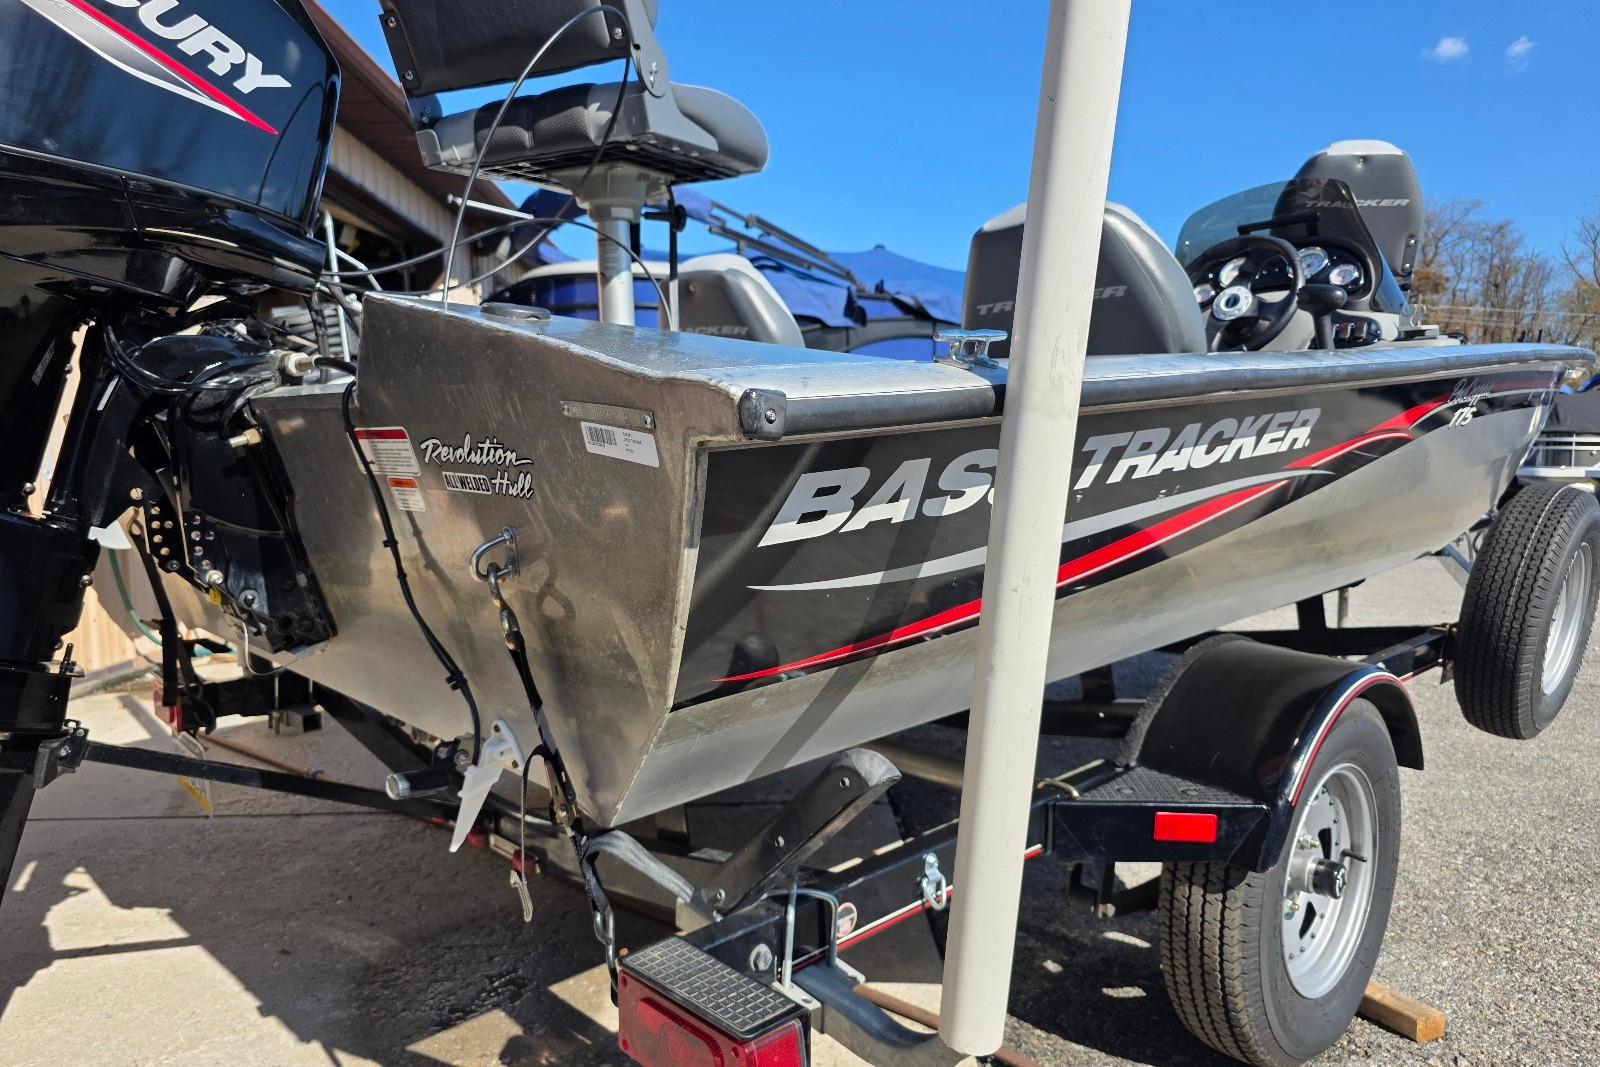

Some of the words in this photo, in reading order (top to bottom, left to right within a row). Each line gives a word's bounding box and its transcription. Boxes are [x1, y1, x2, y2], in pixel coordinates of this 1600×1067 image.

[105, 0, 292, 94] URY
[976, 284, 1128, 316] TRER
[1448, 406, 1478, 428] 175
[420, 432, 534, 468] Revolution
[457, 474, 491, 492] WELDED
[491, 469, 534, 499] Hull
[757, 448, 999, 548] BAS
[1073, 407, 1321, 490] TRACKER
